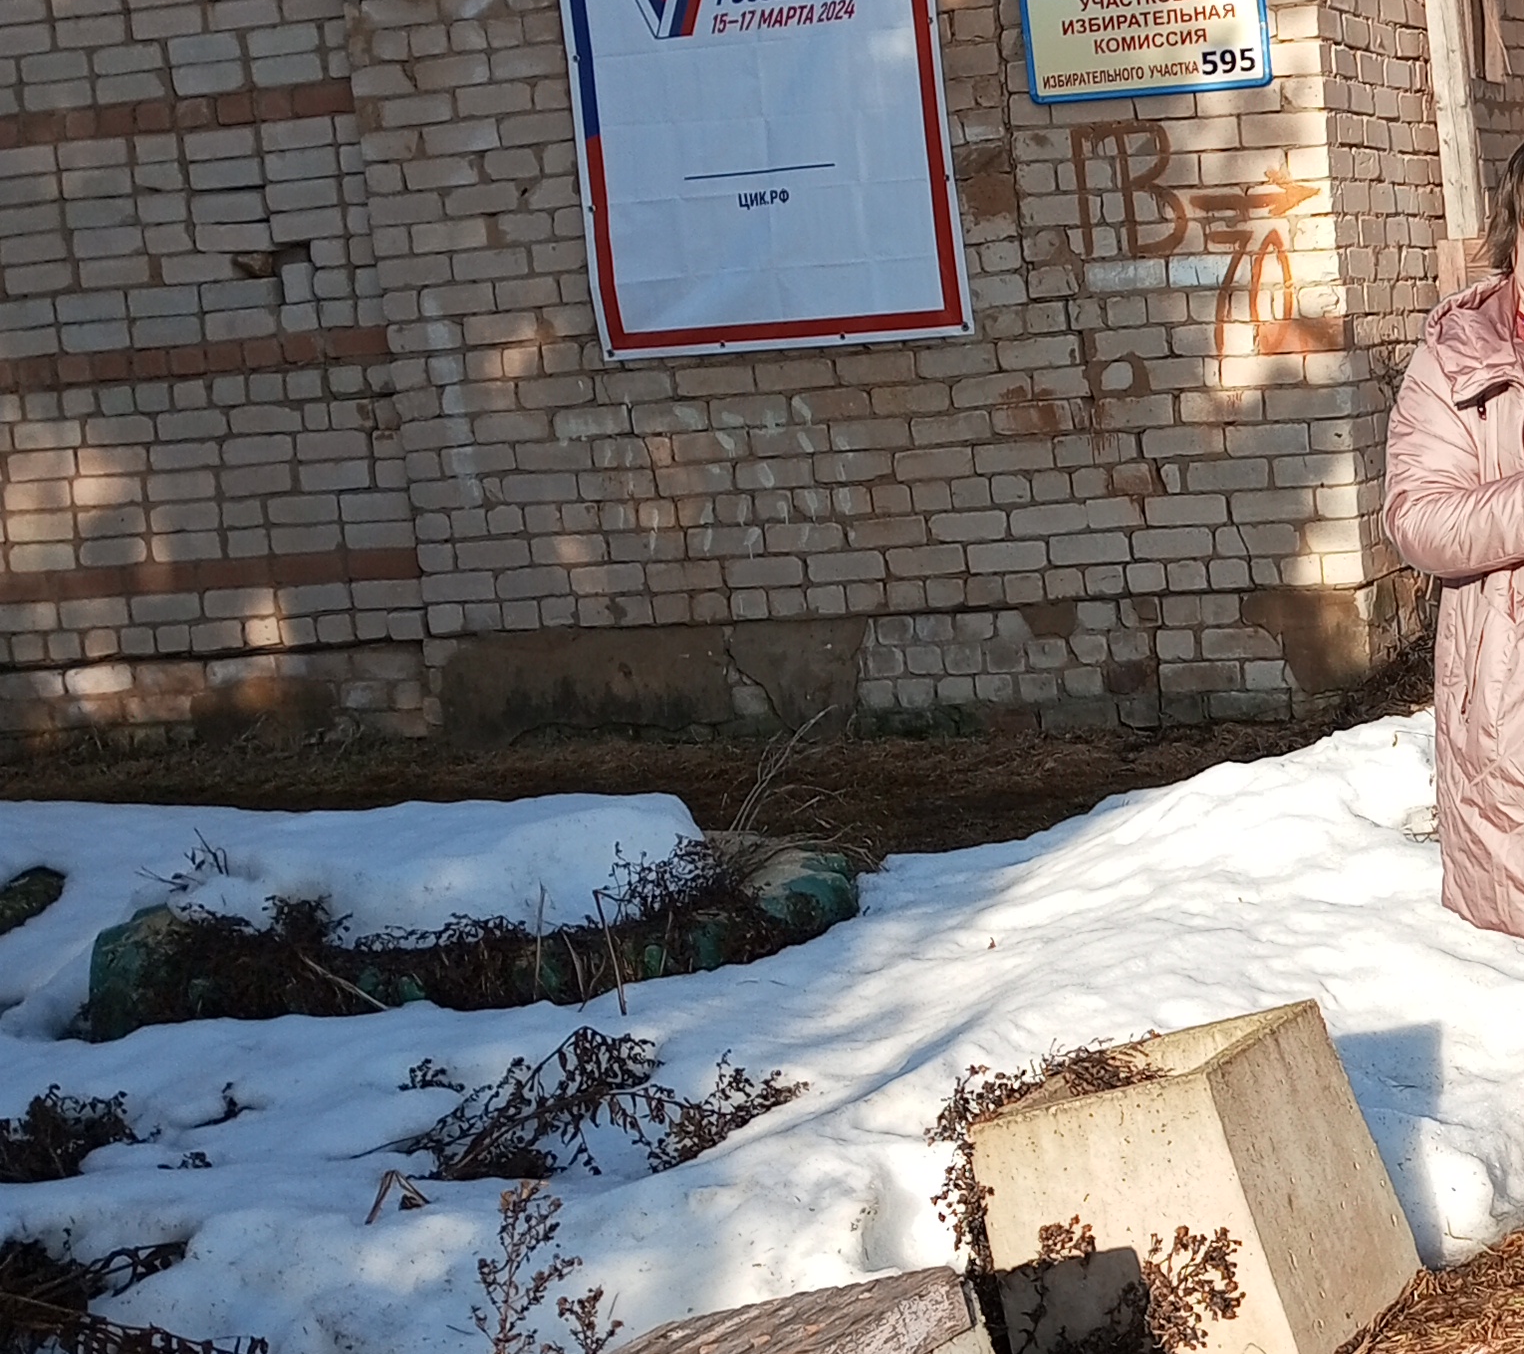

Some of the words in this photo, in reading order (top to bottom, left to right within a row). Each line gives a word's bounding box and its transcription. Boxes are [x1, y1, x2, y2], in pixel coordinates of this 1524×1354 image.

[757, 6, 814, 30] МАРТА
[1061, 2, 1236, 36] ИЗБИРАТЕЛЬНАЯ
[1093, 28, 1208, 55] КОМИССИЯ
[1042, 65, 1145, 90] ИЗБИРАТЕЛЬНОГО
[1149, 60, 1200, 79] УЧАСТКА
[1201, 47, 1256, 76] 595
[738, 188, 790, 210] ЦИК.РФ
